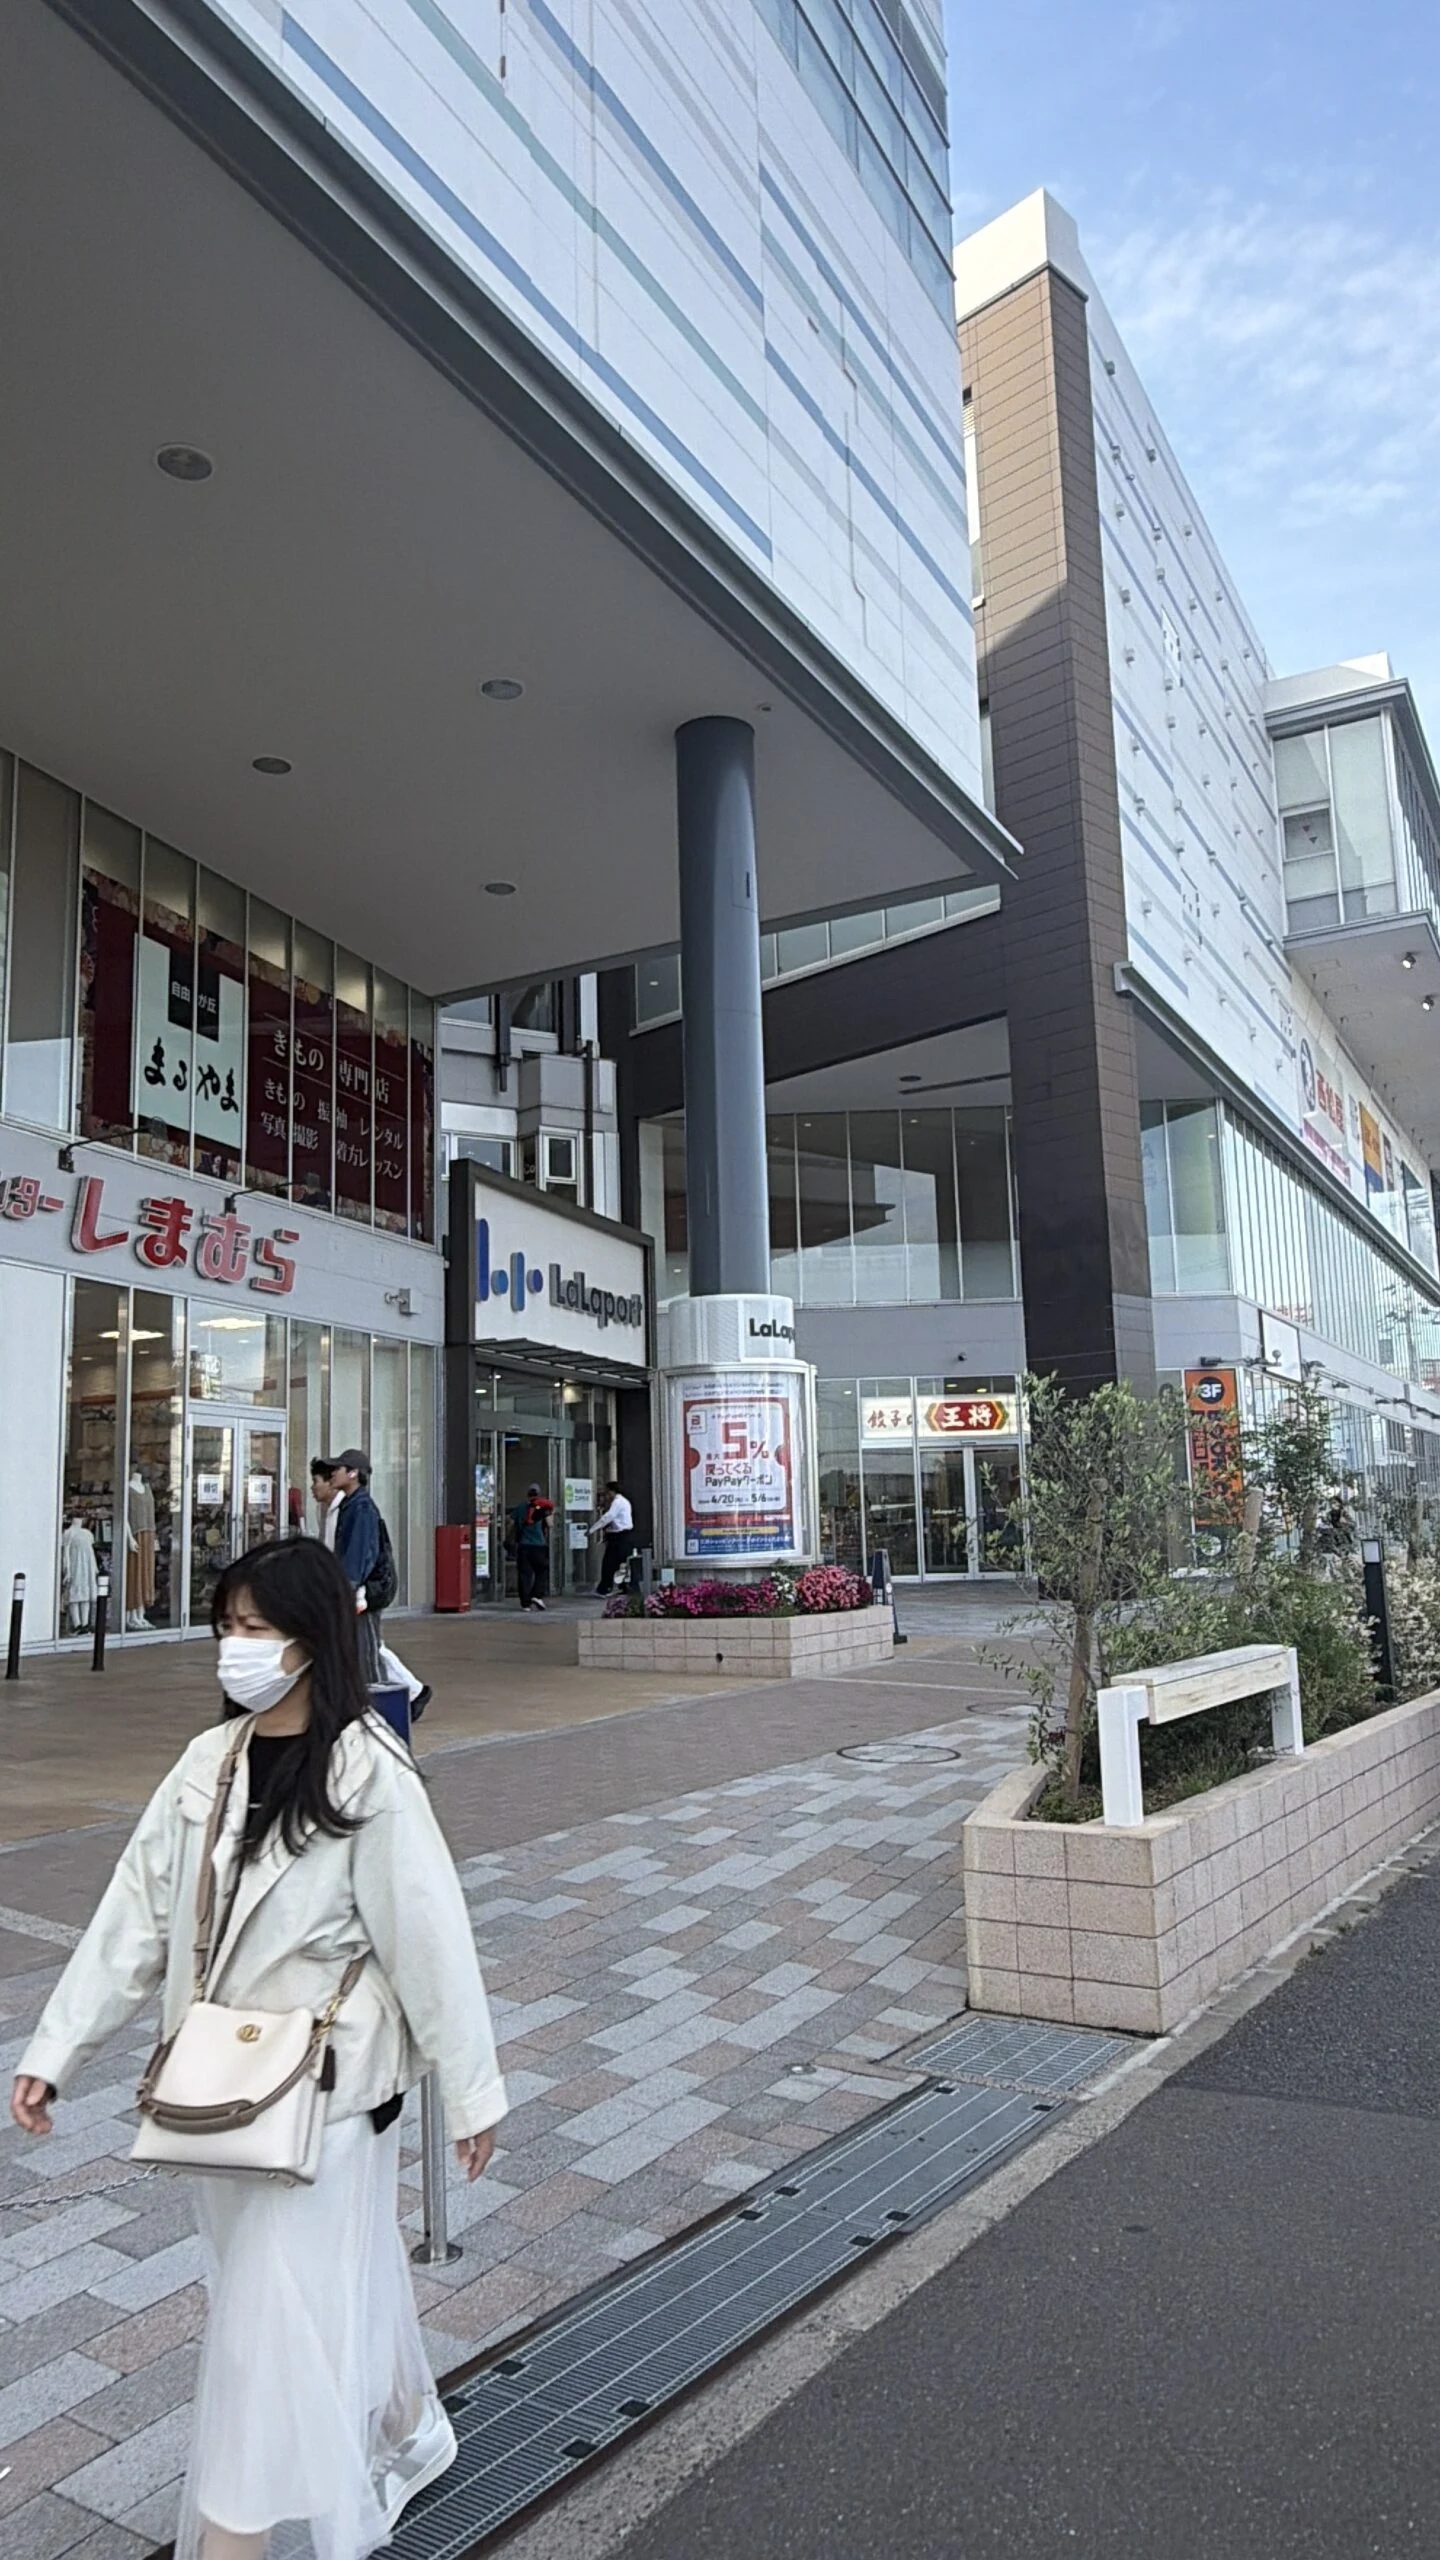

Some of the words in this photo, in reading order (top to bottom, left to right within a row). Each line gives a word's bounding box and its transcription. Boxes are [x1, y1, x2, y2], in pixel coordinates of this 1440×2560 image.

[171, 981, 217, 1014] 自由が丘
[144, 1036, 239, 1114] まるやま
[549, 1263, 642, 1330] LaLaport
[1200, 1383, 1222, 1399] 3F
[941, 1404, 993, 1429] 王将
